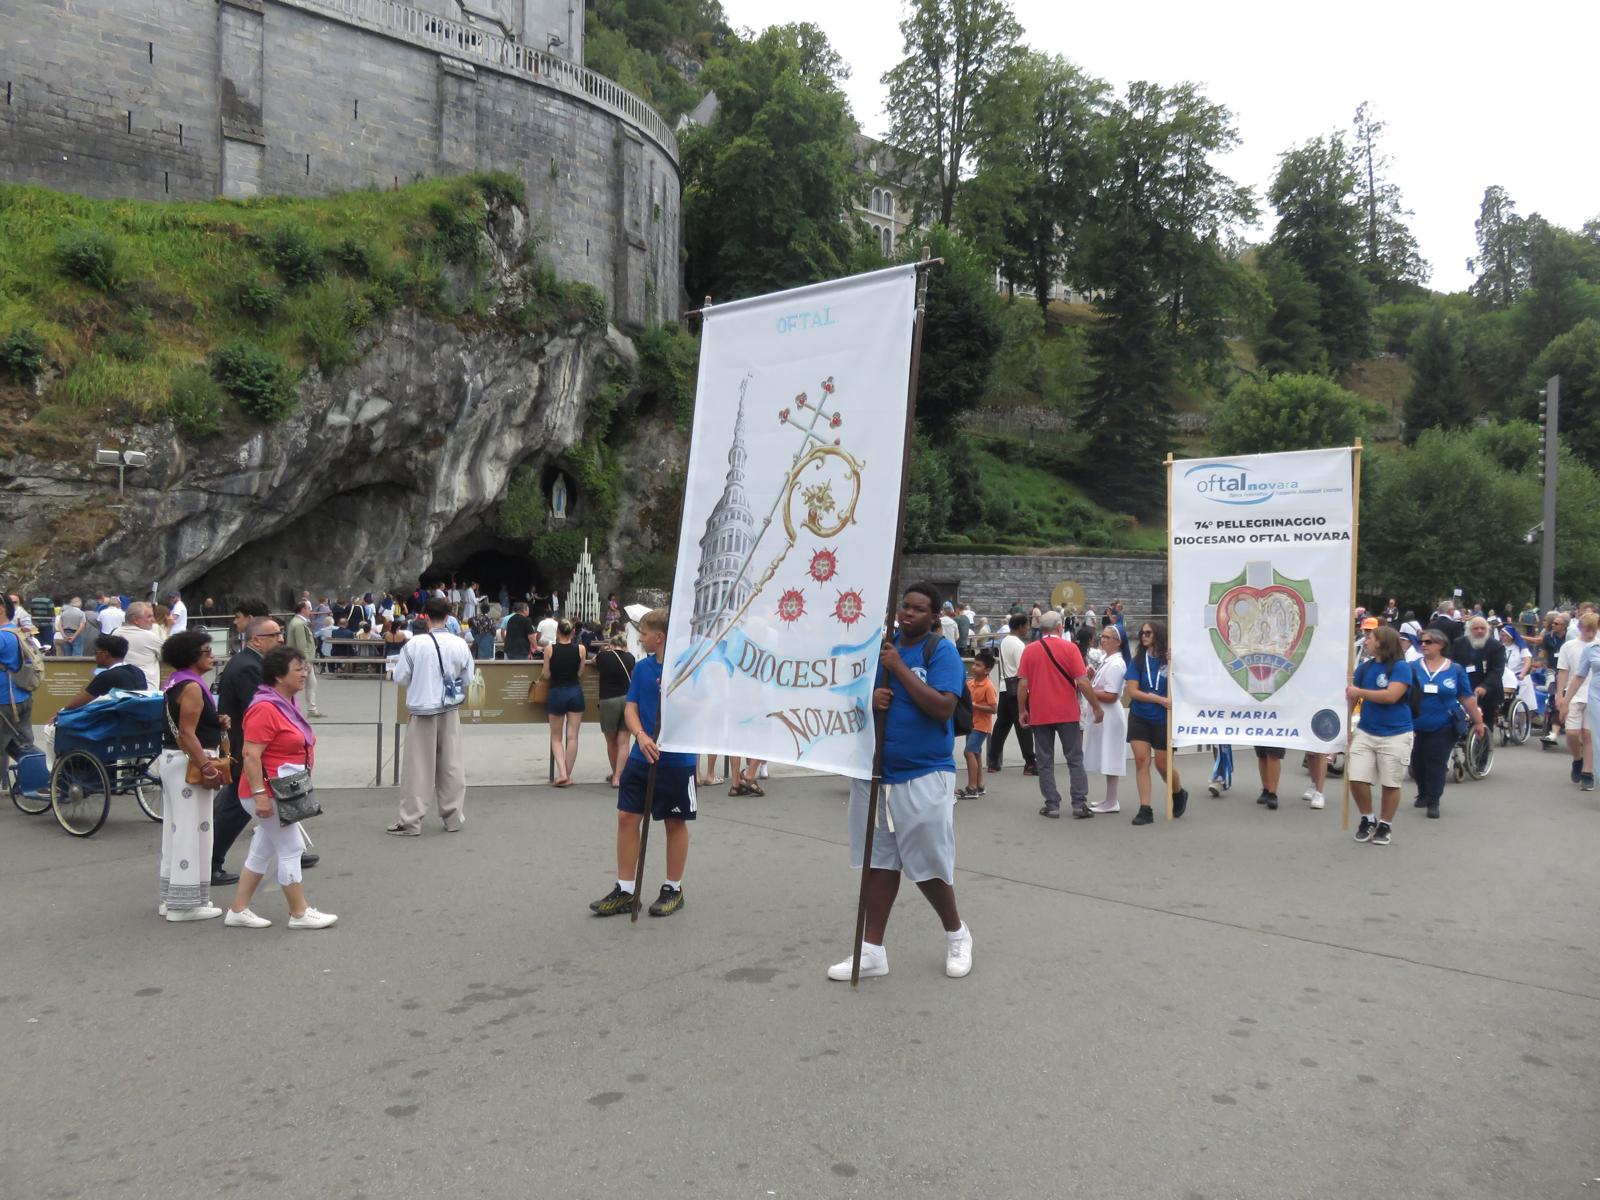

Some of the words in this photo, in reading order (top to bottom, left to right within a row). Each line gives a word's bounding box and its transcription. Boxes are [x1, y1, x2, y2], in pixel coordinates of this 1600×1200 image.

[776, 305, 839, 335] OFTAL
[1216, 516, 1327, 529] PELLEGRINAGGIO
[1174, 535, 1246, 546] DIOCESANO
[1249, 533, 1290, 543] OFTAL
[1294, 531, 1351, 542] NOVARA
[737, 640, 838, 689] DIOCESI
[851, 657, 867, 680] DI
[1197, 709, 1225, 719] AVE
[1231, 710, 1278, 720] MARIA
[1177, 725, 1219, 736] PIENA
[1225, 727, 1240, 736] DI
[1245, 727, 1300, 737] GRAZIA
